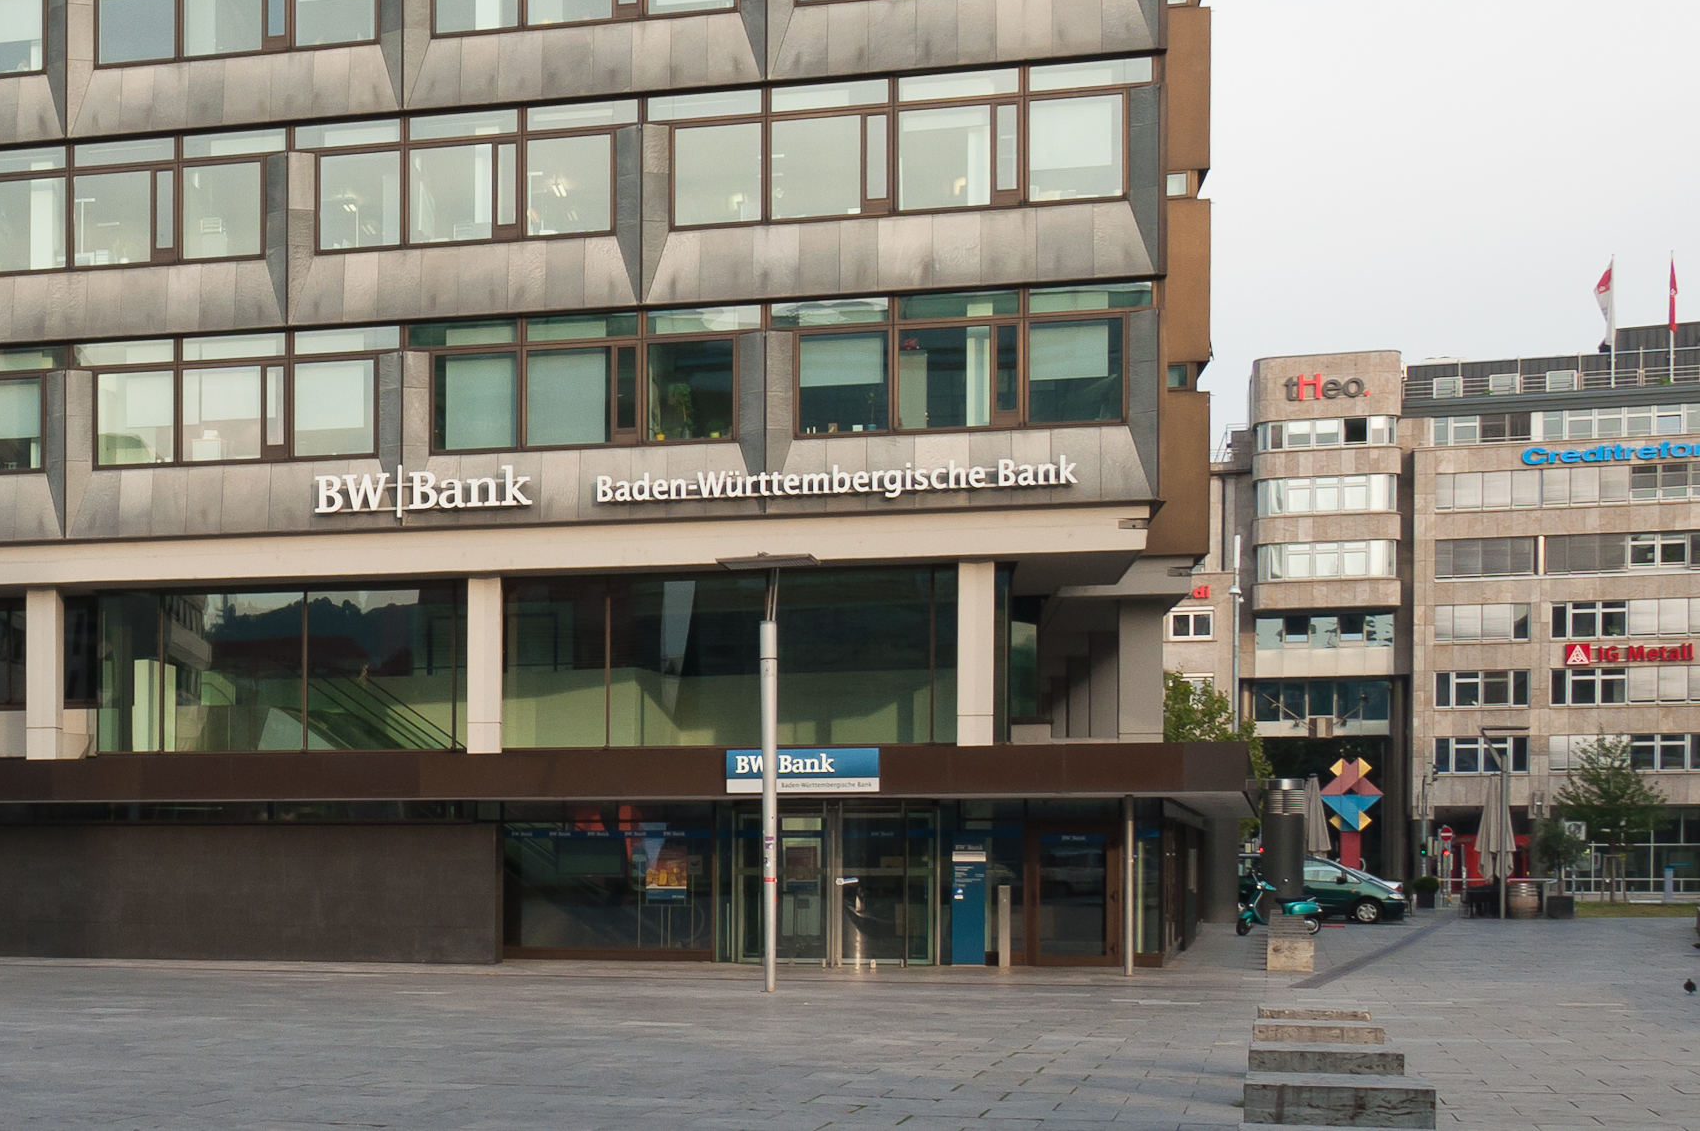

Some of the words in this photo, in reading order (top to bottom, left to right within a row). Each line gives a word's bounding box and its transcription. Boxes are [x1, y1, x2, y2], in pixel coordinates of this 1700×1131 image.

[408, 464, 533, 509] Bank
[596, 460, 987, 502] Baden-Württembergische
[997, 455, 1079, 487] Bank
[1598, 645, 1620, 662] IG
[1627, 643, 1694, 661] Metall
[778, 753, 835, 774] Bank
